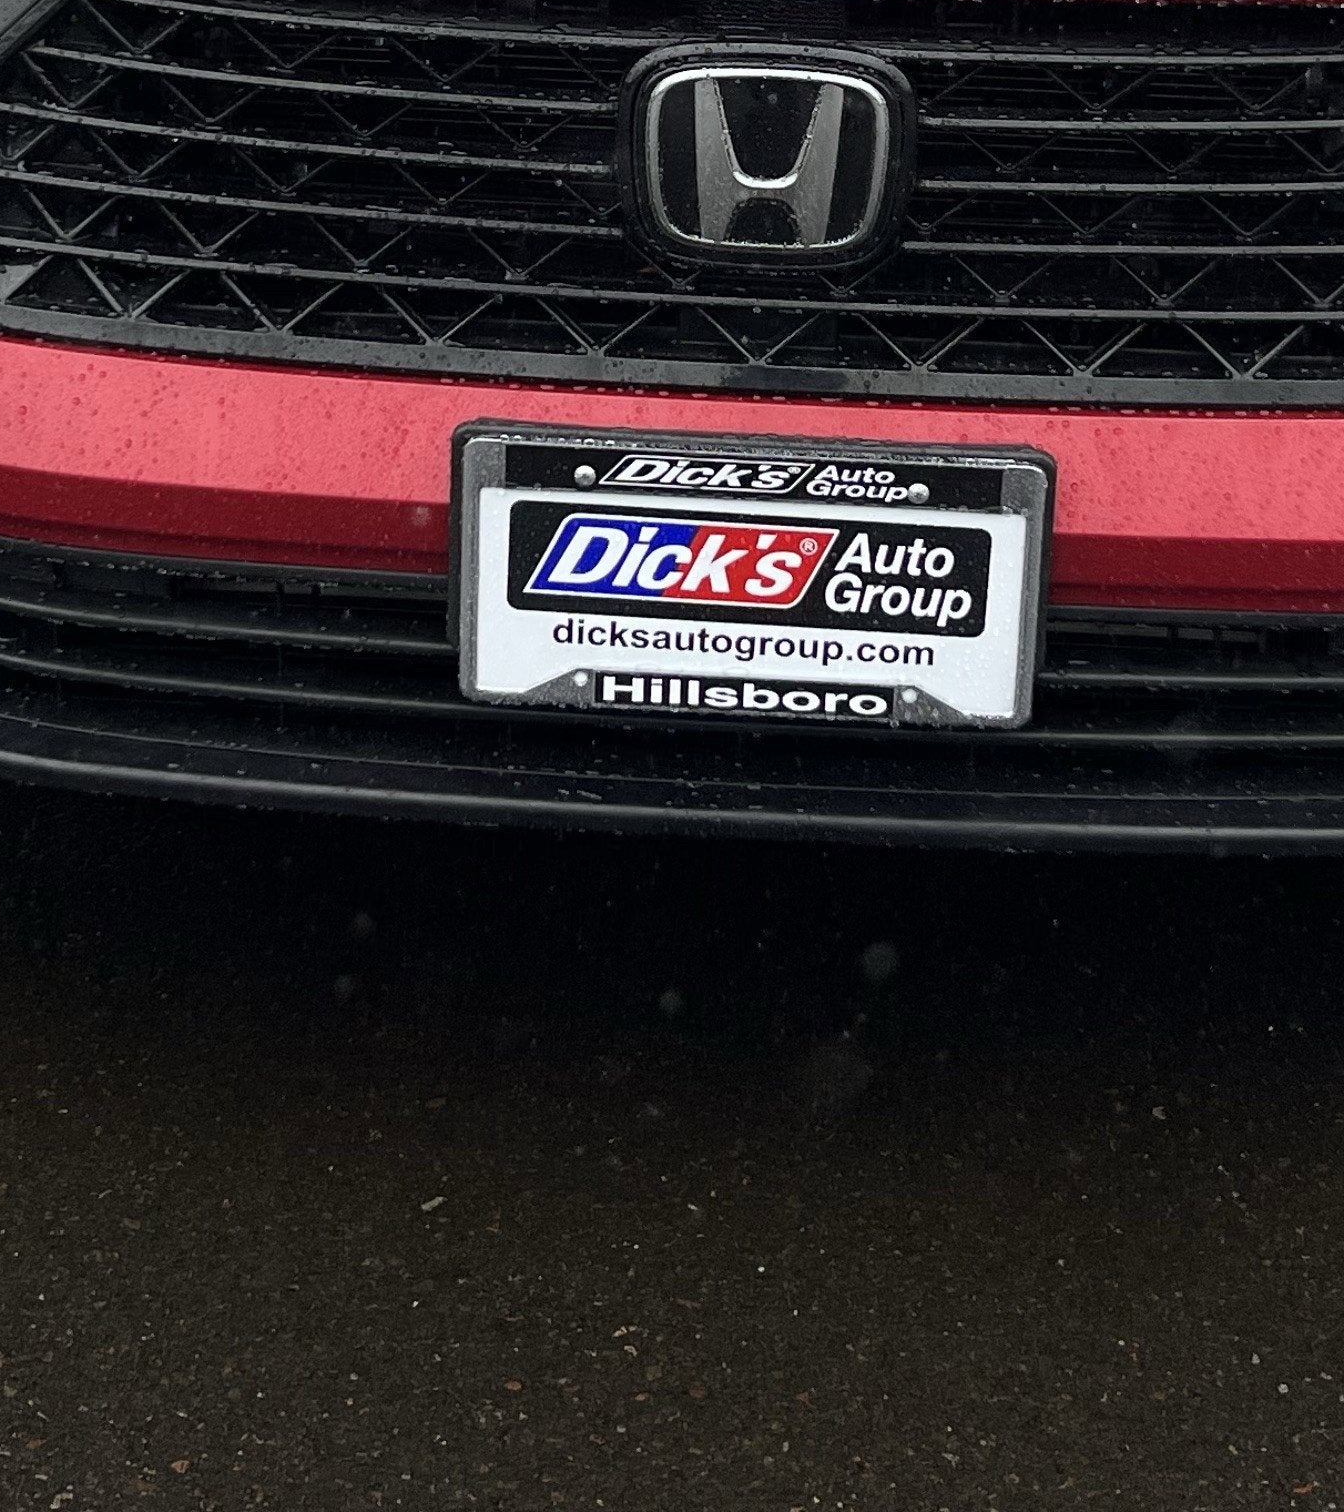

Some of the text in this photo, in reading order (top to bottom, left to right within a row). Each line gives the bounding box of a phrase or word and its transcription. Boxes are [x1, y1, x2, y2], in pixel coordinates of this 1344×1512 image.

[615, 459, 791, 489] Dick's
[806, 478, 908, 503] Group
[813, 465, 896, 484] Auto
[548, 525, 804, 598] Dick's
[835, 532, 955, 579] Auto
[824, 571, 972, 628] Group
[552, 618, 935, 666] dicksautogroup.com
[602, 675, 888, 716] Hillsboro
